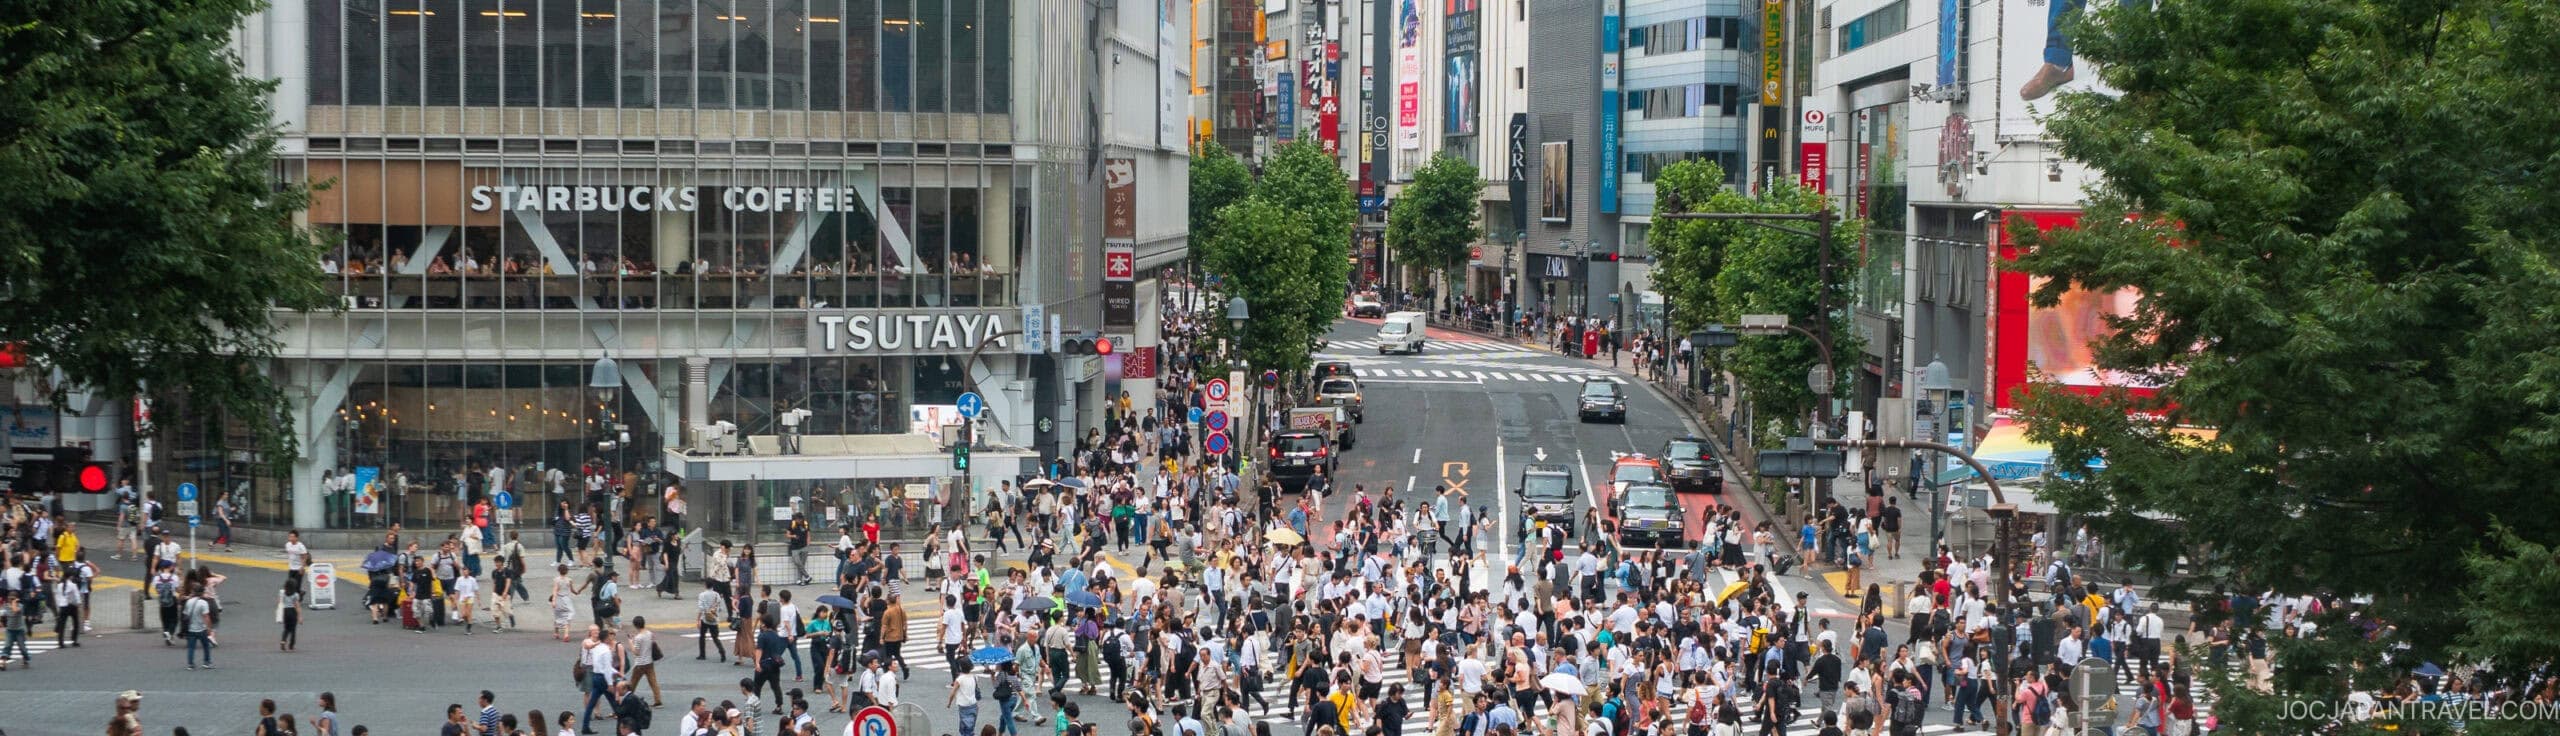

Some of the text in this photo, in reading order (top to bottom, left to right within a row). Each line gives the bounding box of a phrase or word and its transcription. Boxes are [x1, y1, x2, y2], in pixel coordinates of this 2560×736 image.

[1511, 124, 1525, 181] ZARA
[471, 185, 854, 213] STARBUCKS COFFEE
[1110, 255, 1129, 275] 本
[1545, 256, 1569, 277] ZARA
[818, 313, 1008, 351] TSUTAYA
[1125, 357, 1146, 367] SALE
[1125, 366, 1146, 378] SALE
